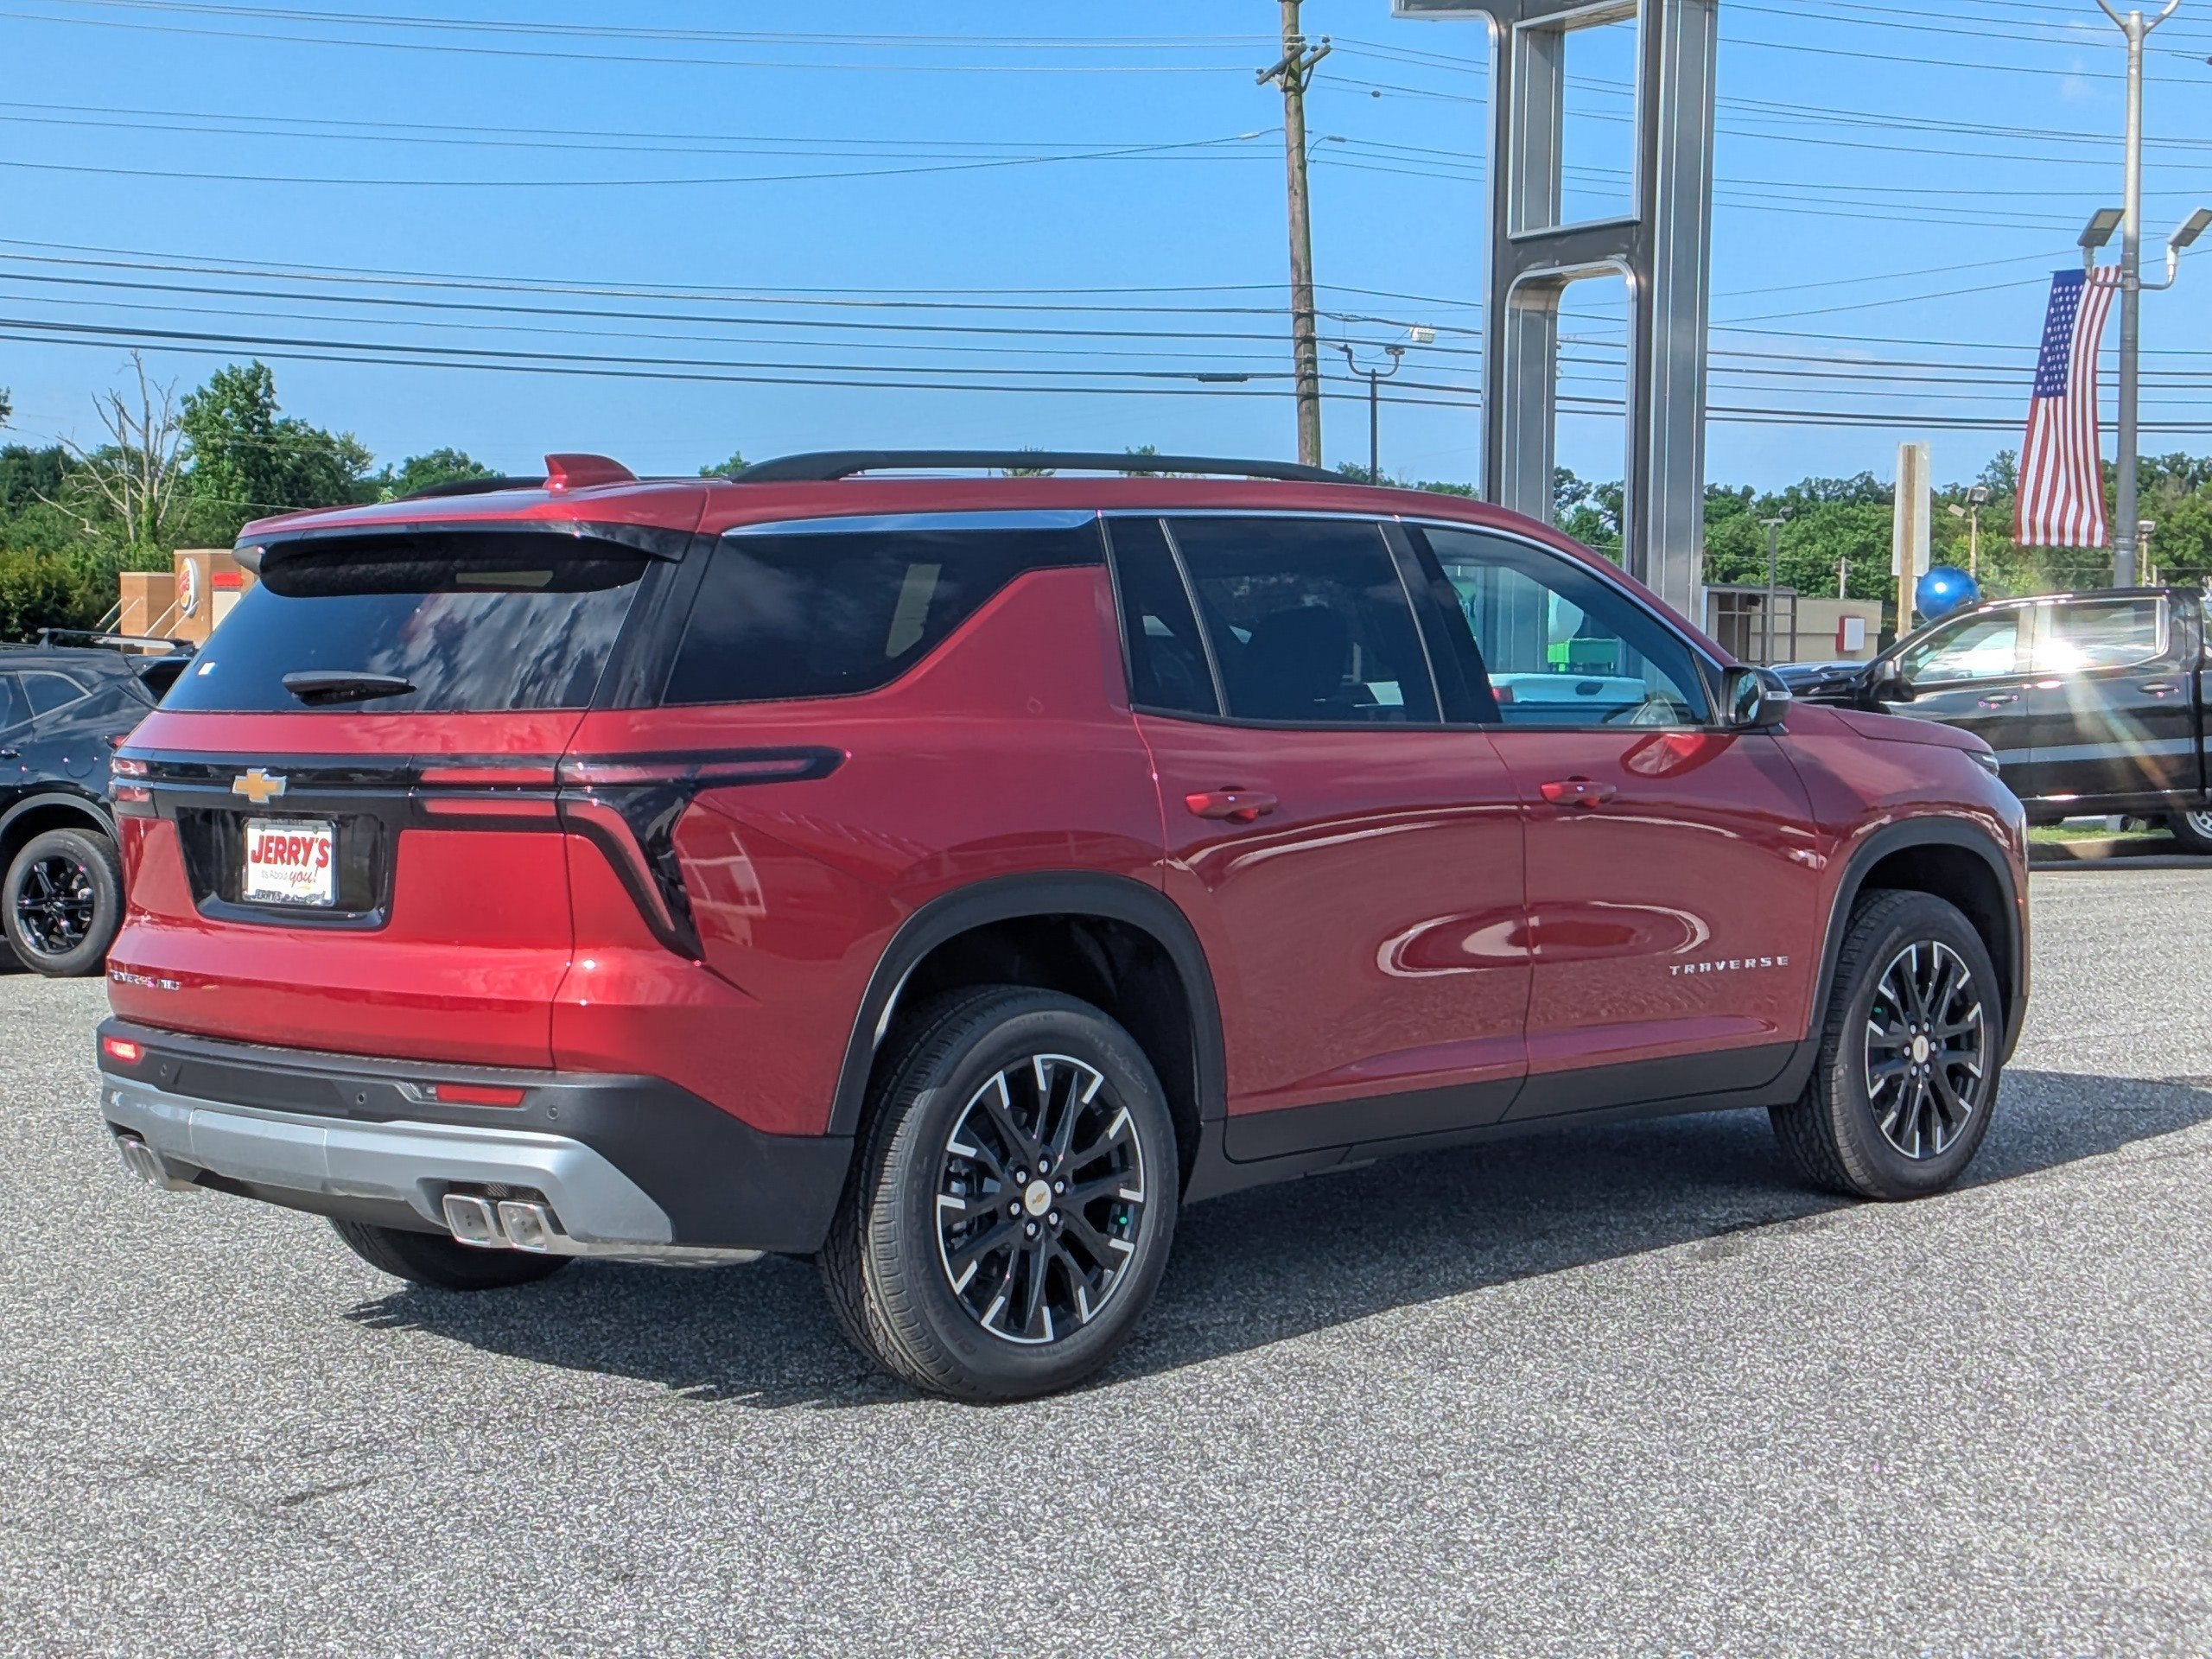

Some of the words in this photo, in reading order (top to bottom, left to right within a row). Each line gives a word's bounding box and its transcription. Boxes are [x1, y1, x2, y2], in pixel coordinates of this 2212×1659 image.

[251, 835, 332, 868] JERRY'S
[289, 866, 319, 888] you!
[1669, 956, 1789, 976] TRAVERSE
